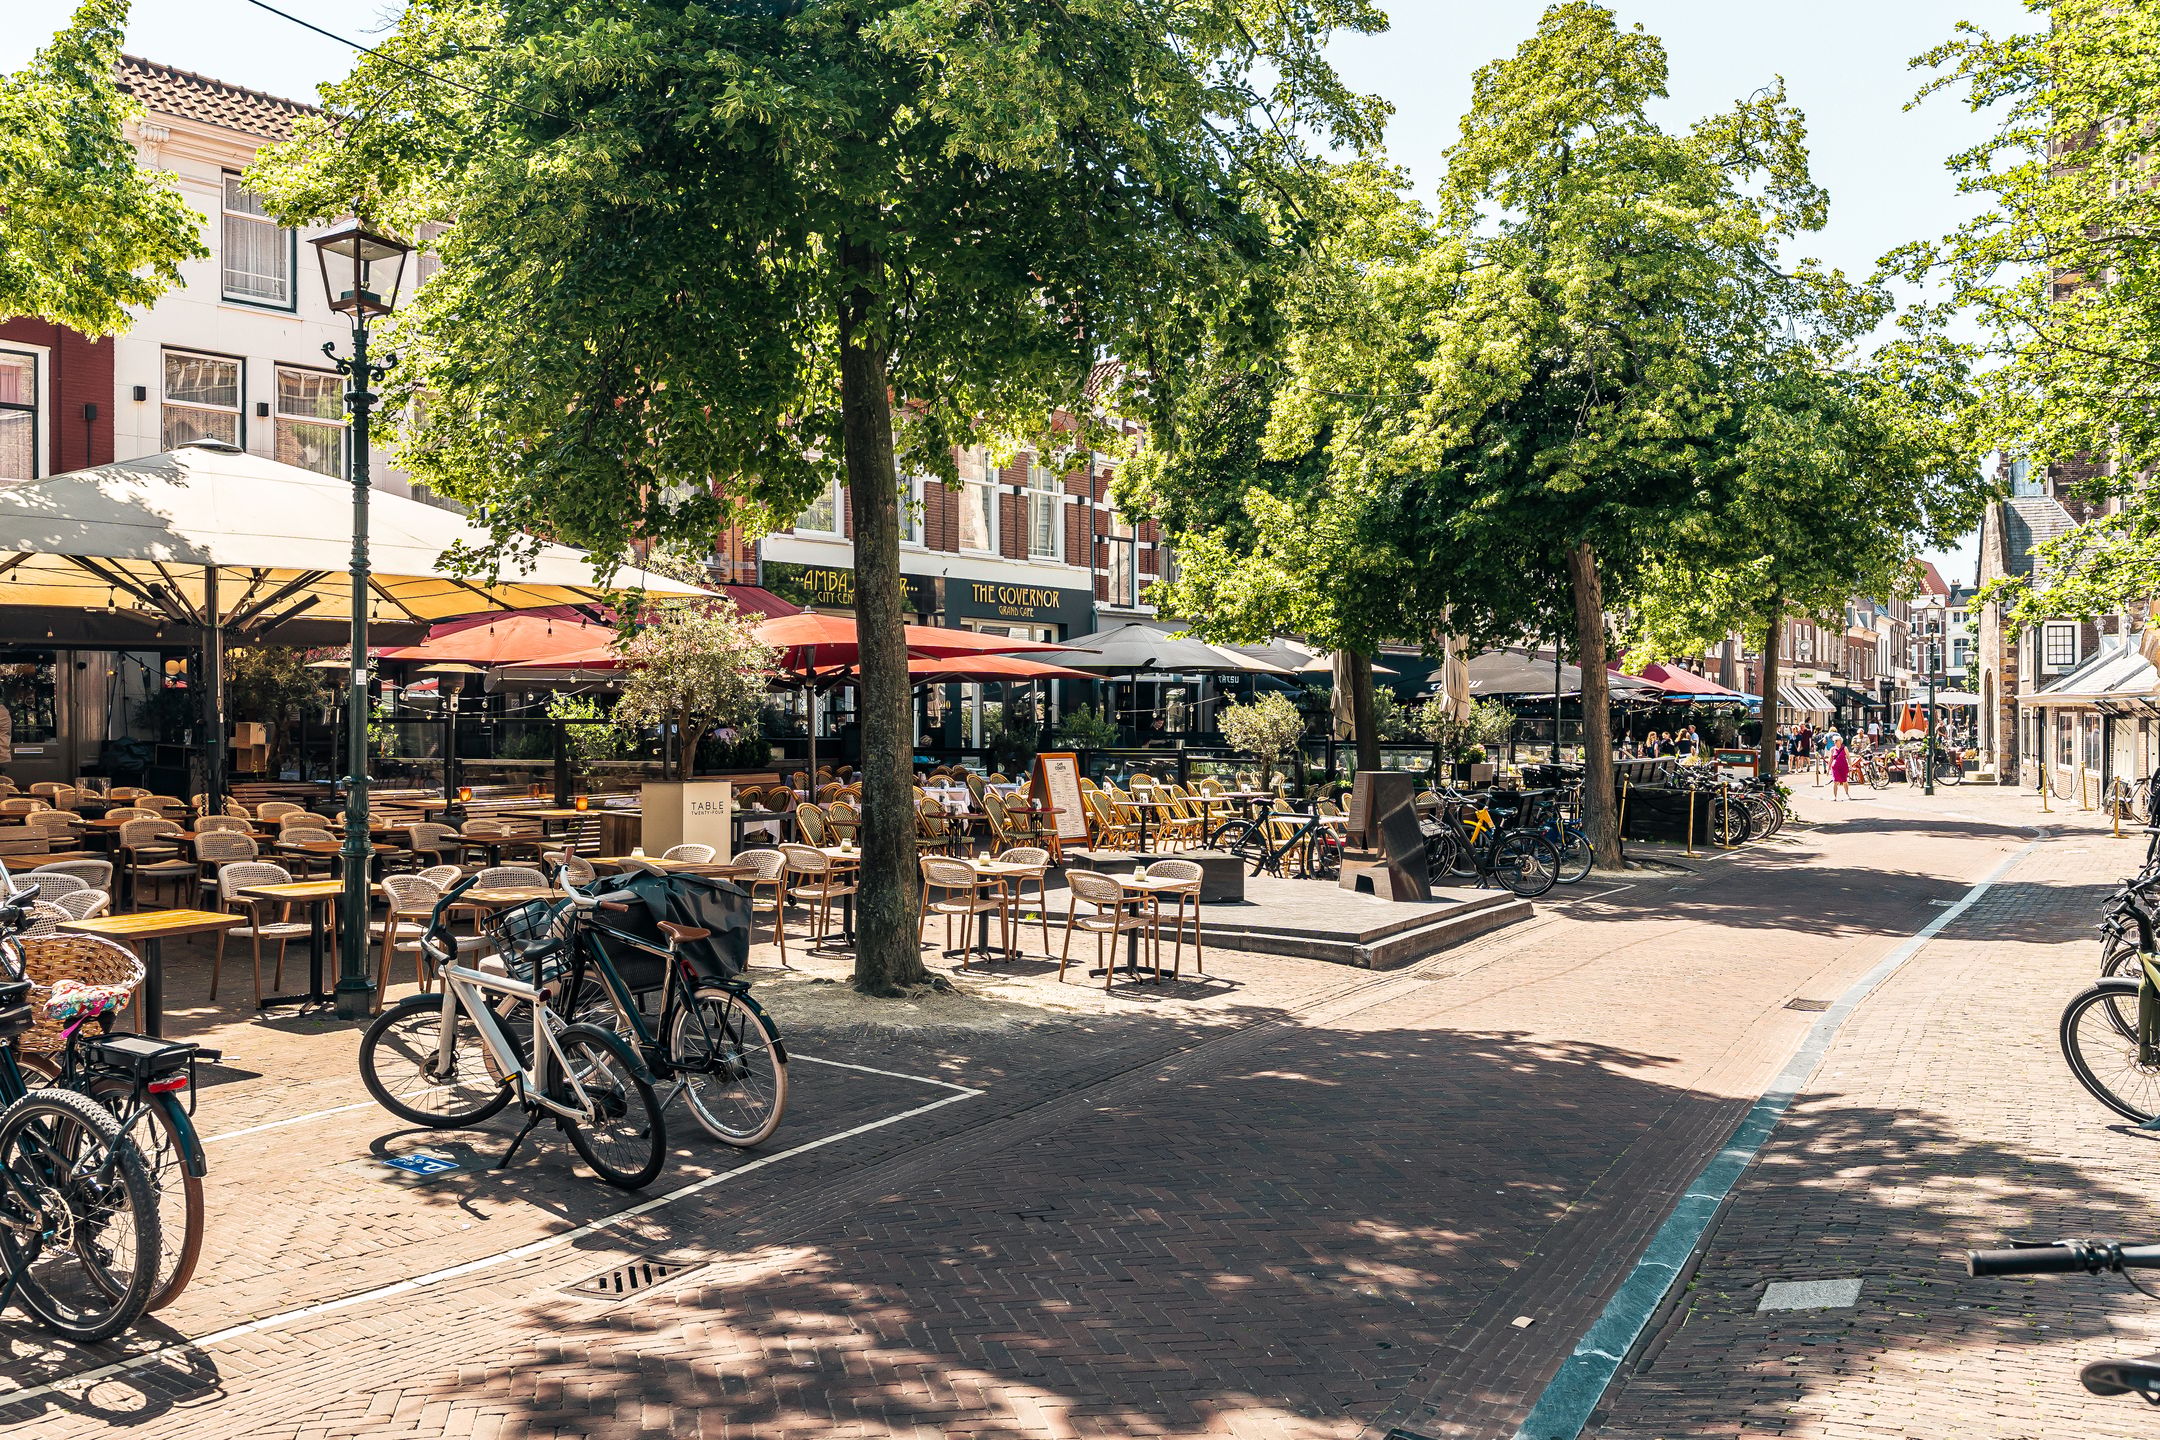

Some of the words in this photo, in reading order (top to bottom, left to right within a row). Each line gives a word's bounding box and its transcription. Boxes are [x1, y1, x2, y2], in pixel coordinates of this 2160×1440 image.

[803, 569, 908, 598] AMBAR
[817, 591, 834, 603] CITY
[837, 592, 855, 605] CEN
[972, 583, 996, 604] THE
[998, 586, 1060, 608] GOVERNOR
[998, 605, 1019, 617] GRAND
[1019, 607, 1035, 618] CAFE
[691, 801, 724, 811] TABLE
